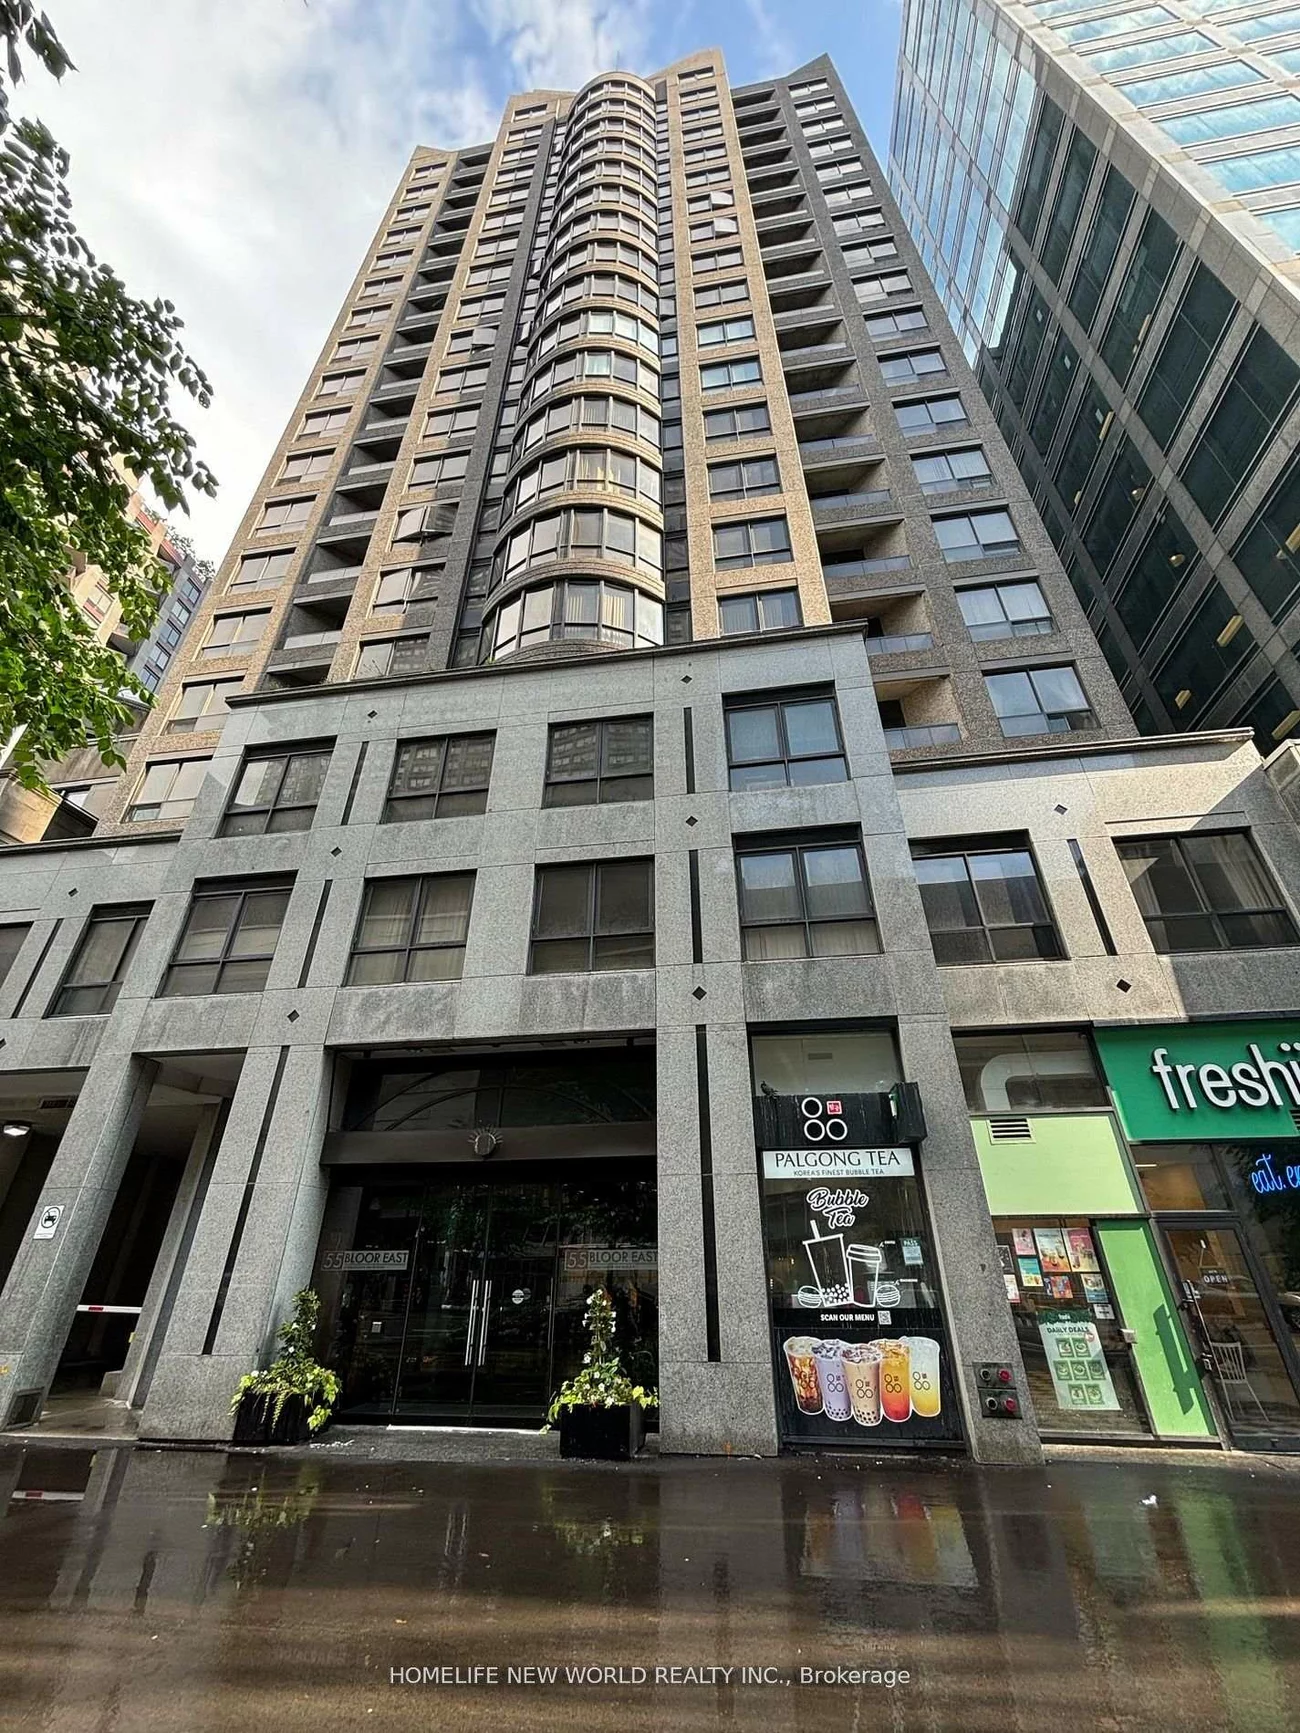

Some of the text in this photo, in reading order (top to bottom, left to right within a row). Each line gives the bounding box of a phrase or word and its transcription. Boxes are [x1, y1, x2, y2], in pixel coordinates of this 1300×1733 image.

[1151, 1042, 1300, 1109] freshi
[775, 1150, 900, 1168] PALGONG TEA
[793, 1169, 819, 1177] KOREA'S
[845, 1168, 870, 1176] BUBBLE
[1251, 1153, 1287, 1194] eat.
[807, 1187, 869, 1211] Bubble
[823, 1207, 855, 1229] Tea
[323, 1252, 344, 1269] 55
[344, 1252, 381, 1263] BLOOR
[382, 1252, 409, 1263] EAST
[566, 1252, 587, 1269] 55
[589, 1251, 628, 1263] BLOOR
[631, 1251, 658, 1263] EAST
[1203, 1274, 1229, 1283] OPEN
[820, 1313, 875, 1321] SCAN OUR MENU
[1046, 1325, 1090, 1334] DAILY DEALS
